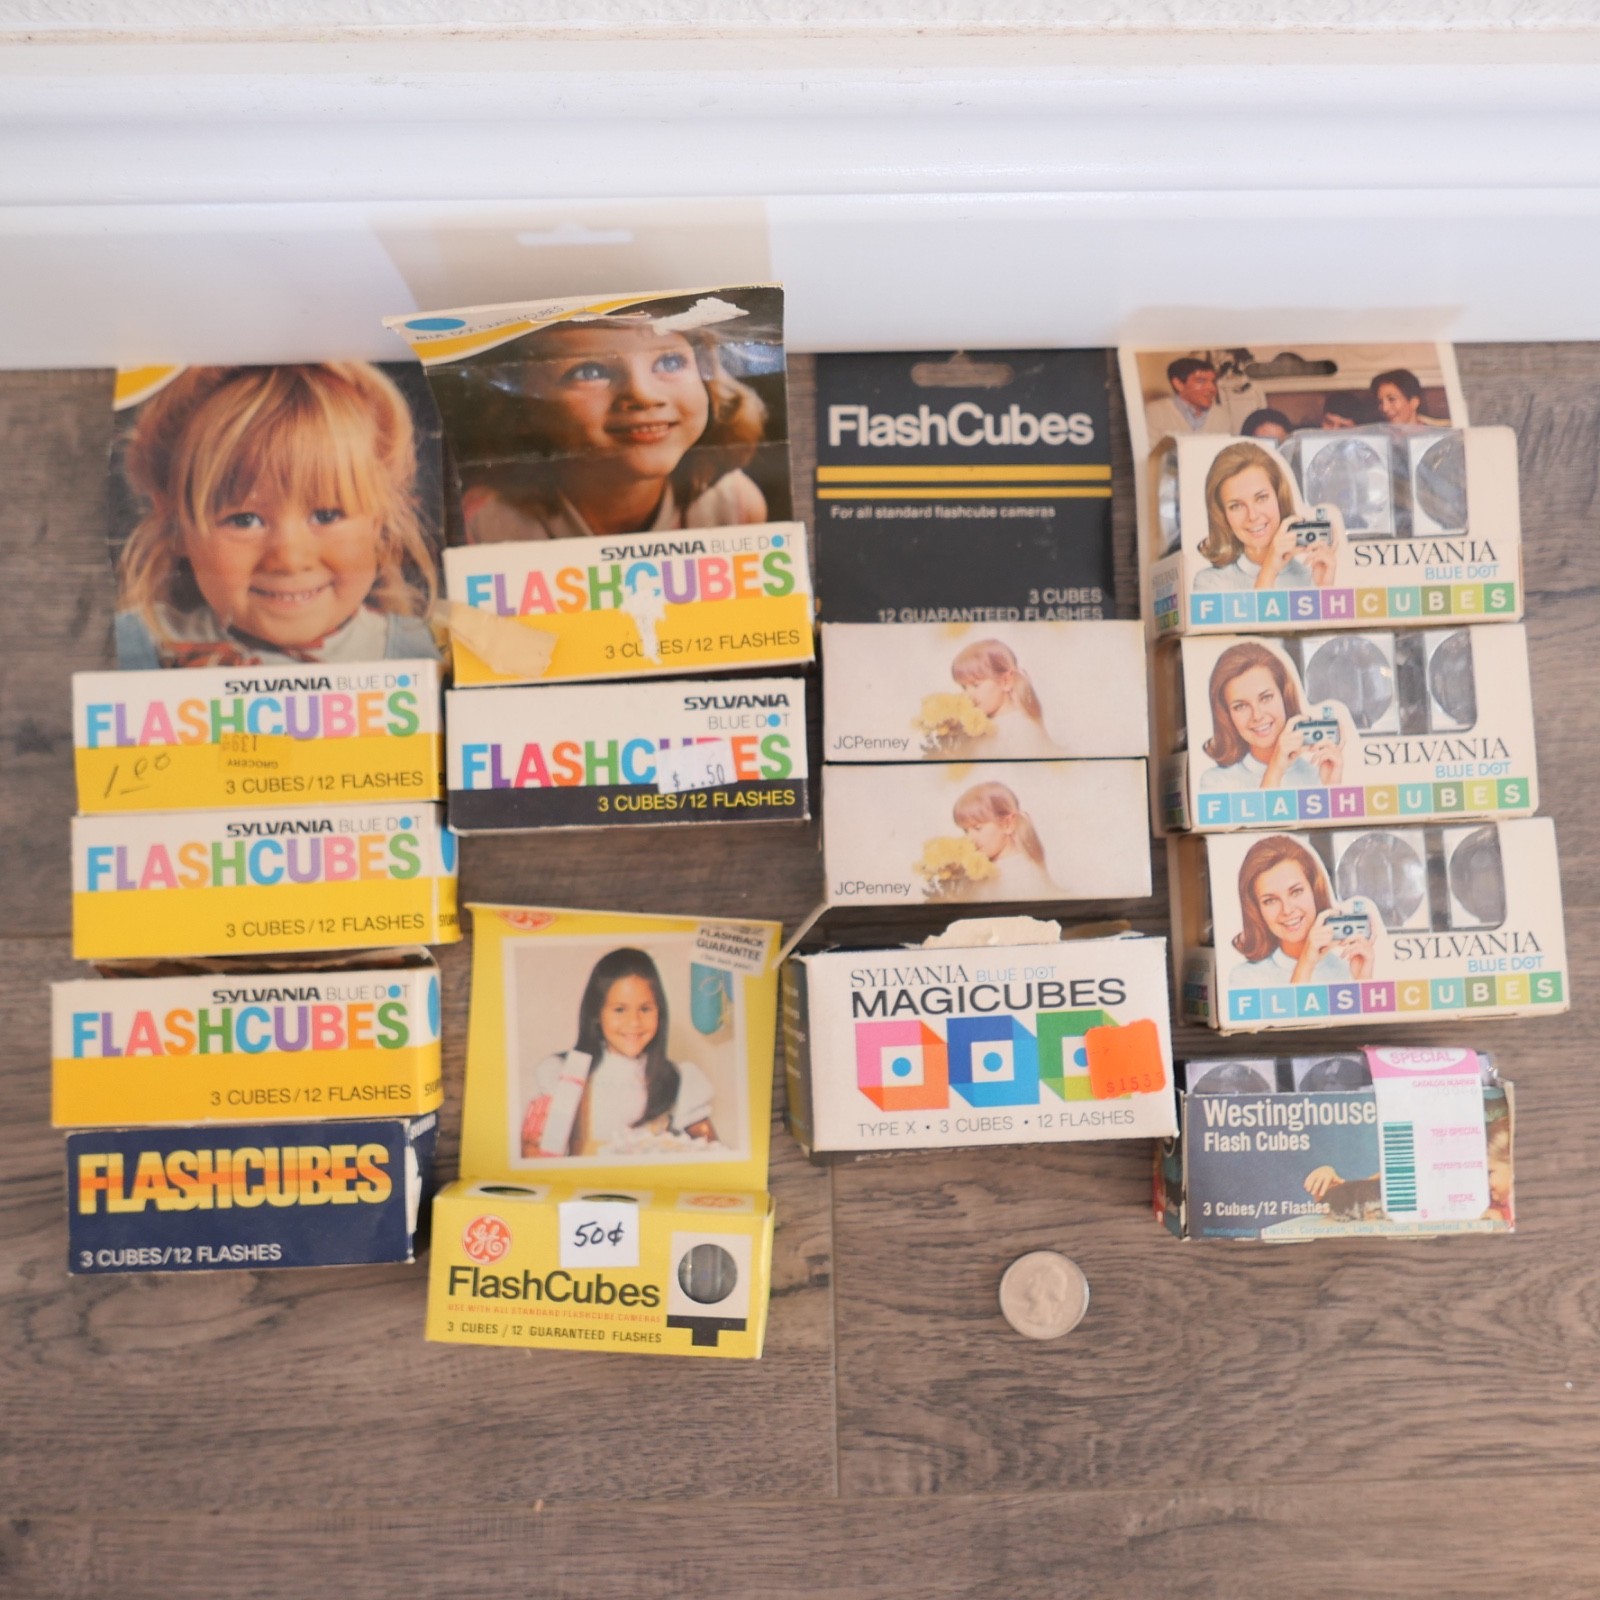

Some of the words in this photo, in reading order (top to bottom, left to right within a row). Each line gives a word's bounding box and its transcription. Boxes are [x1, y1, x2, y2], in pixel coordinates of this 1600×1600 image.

[828, 402, 1094, 447] FlashCubes
[831, 505, 853, 519] For
[857, 505, 873, 519] all
[876, 505, 932, 519] standard
[935, 505, 997, 519] flashcube
[1000, 506, 1056, 519] cameras
[601, 540, 706, 561] SYLVANIA
[711, 538, 752, 554] BLUE
[758, 534, 792, 551] DOT
[1354, 540, 1498, 568] SYLVANIA
[1425, 566, 1463, 581] BLUE
[1467, 564, 1499, 580] DOT
[1029, 588, 1039, 604] 3
[1043, 588, 1103, 604] CUBES
[1199, 588, 1506, 619] FLASHCUBES
[878, 607, 896, 623] 12
[900, 606, 1020, 623] GUARANTEED
[1024, 606, 1103, 622] FLASHES
[605, 645, 615, 660] 3
[720, 630, 801, 651] FLASHES
[225, 676, 332, 695] SYLVANIA
[337, 675, 379, 691] BLUE
[384, 673, 420, 689] DOT
[684, 693, 790, 711] SYLVANIA
[86, 691, 420, 749] FLASHCUBES
[708, 714, 750, 731] BLUE
[756, 712, 791, 729] DOT
[833, 736, 910, 751] JCPenney
[1363, 737, 1511, 767] SYLVANIA
[462, 734, 793, 790] FLASHCES
[1435, 763, 1474, 779] BLUE
[1478, 761, 1513, 778] DOT
[226, 780, 236, 794] 3
[342, 771, 424, 789] FLASHES
[598, 798, 609, 812] 3
[713, 790, 796, 808] FLASHES
[1206, 783, 1520, 820] FLASHCUBES
[226, 819, 333, 838] SYLVANIA
[339, 817, 382, 833] BLUE
[386, 815, 421, 831] DOT
[87, 833, 422, 892] FLASHCUBES
[835, 881, 911, 896] JCPenney
[226, 923, 236, 938] 3
[342, 914, 425, 932] FLASHES
[696, 938, 761, 960] GUARANTEE
[1393, 931, 1542, 961] SYLVANIA
[1468, 957, 1507, 973] BLUE
[1511, 954, 1545, 971] DOT
[850, 965, 970, 988] SYLVANIA
[976, 967, 1017, 983] BLUE
[1024, 965, 1057, 981] DOT
[212, 986, 320, 1004] SYLVANIA
[326, 985, 369, 1001] BLUE
[374, 984, 410, 999] DOT
[852, 978, 1127, 1018] MAGICUBES
[1237, 977, 1554, 1015] FLASHCUBES
[72, 1002, 410, 1058] FLASHCUBES
[1390, 1050, 1456, 1065] SPECIAL
[210, 1090, 220, 1105] 3
[329, 1084, 411, 1102] FLASHES
[857, 1121, 900, 1137] TYPE
[905, 1121, 917, 1134] X
[939, 1120, 949, 1134] 3
[957, 1116, 1014, 1133] CUBES
[1037, 1113, 1053, 1129] 12
[1059, 1110, 1136, 1127] FLASHES
[1203, 1099, 1377, 1131] Westinghouse
[1204, 1132, 1252, 1153] Flash
[1255, 1131, 1311, 1151] Cubes
[77, 1143, 393, 1215] FLASHCUBES
[1203, 1202, 1212, 1216] 3
[1281, 1200, 1331, 1215] Flashes
[79, 1250, 94, 1268] 3
[197, 1244, 282, 1263] FLASHES
[448, 1265, 661, 1308] FlashCubes
[447, 1321, 454, 1332] 3
[461, 1322, 498, 1334] CUBES
[530, 1326, 605, 1341] GUARANTEED
[612, 1331, 662, 1343] FLASHES
